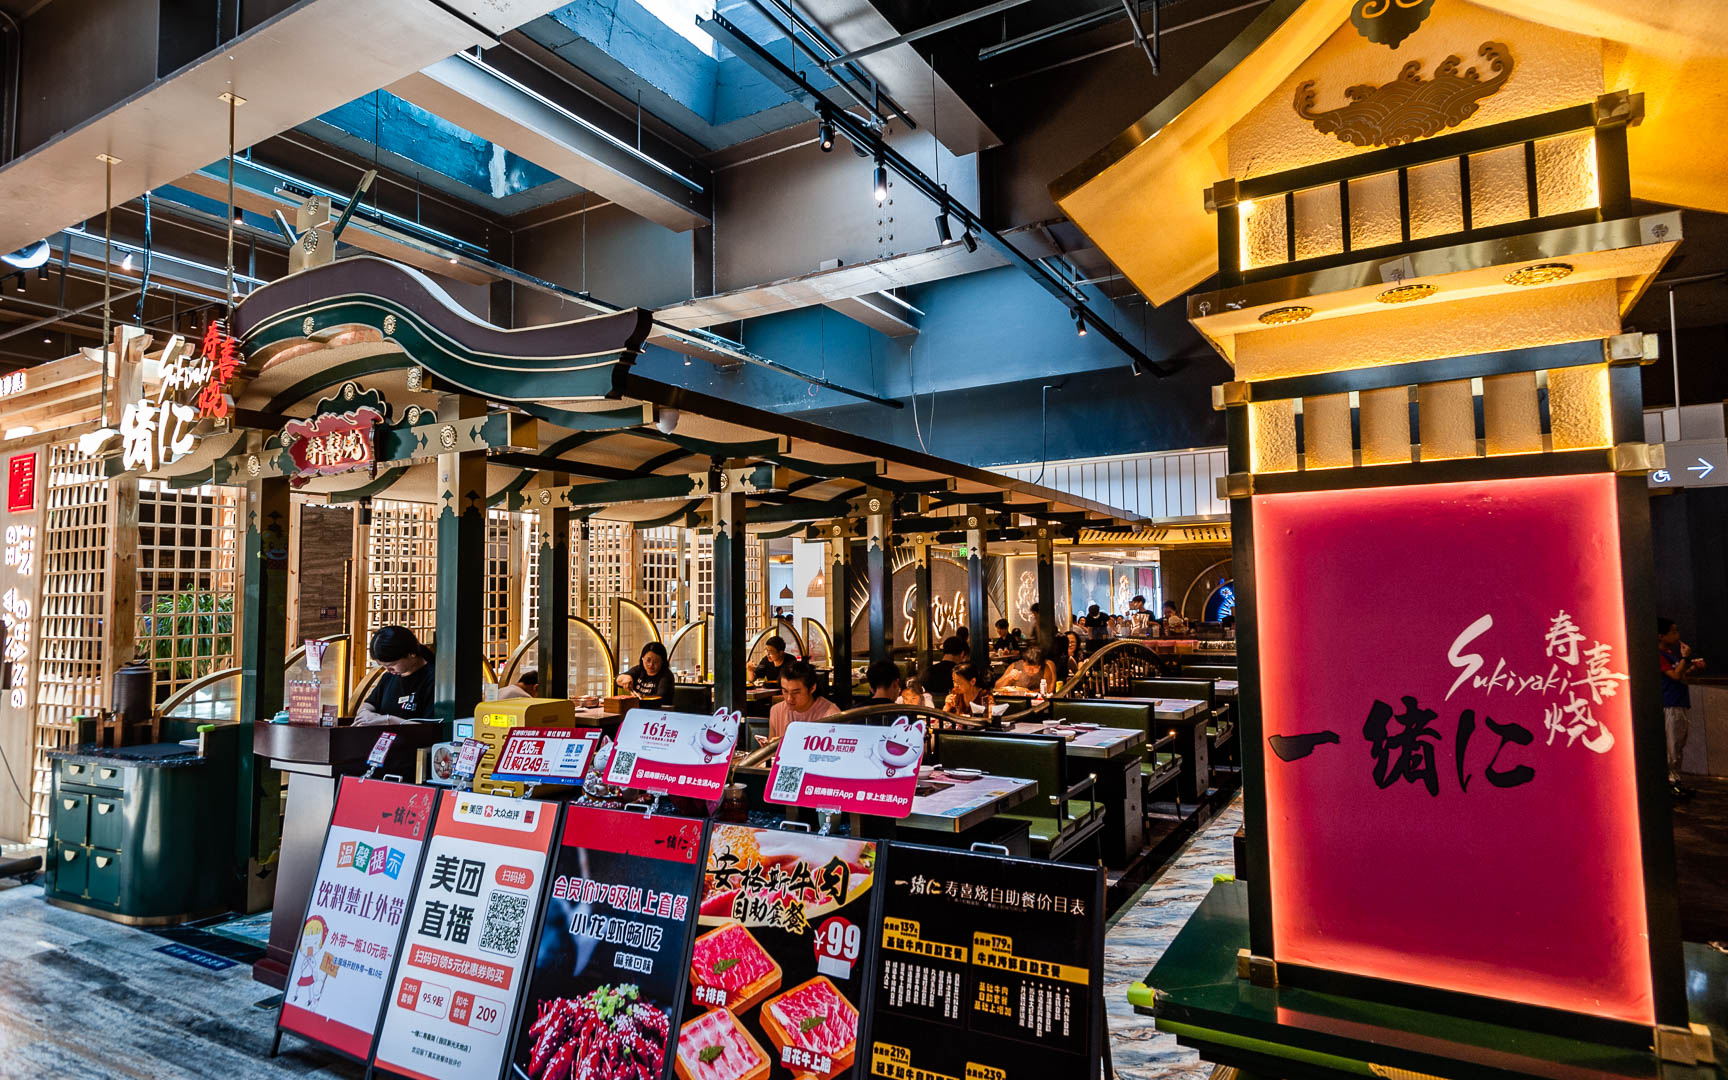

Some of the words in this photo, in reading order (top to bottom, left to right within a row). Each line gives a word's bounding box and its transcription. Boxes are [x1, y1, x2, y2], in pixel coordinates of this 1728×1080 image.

[1445, 614, 1571, 701] Sukiyaki
[493, 808, 520, 820] 大众点评
[338, 844, 403, 877] 温馨提示
[429, 854, 486, 897] 美团
[317, 880, 405, 927] 饮料禁止外带
[418, 900, 475, 944] 直播
[731, 892, 808, 935] 自助套餐
[569, 912, 664, 951] 小龙虾畅吃
[813, 920, 861, 960] ¥99
[414, 948, 505, 984] 扫码可领5元优惠券购买
[613, 952, 653, 974] 麻辣口味
[476, 1004, 497, 1023] 209
